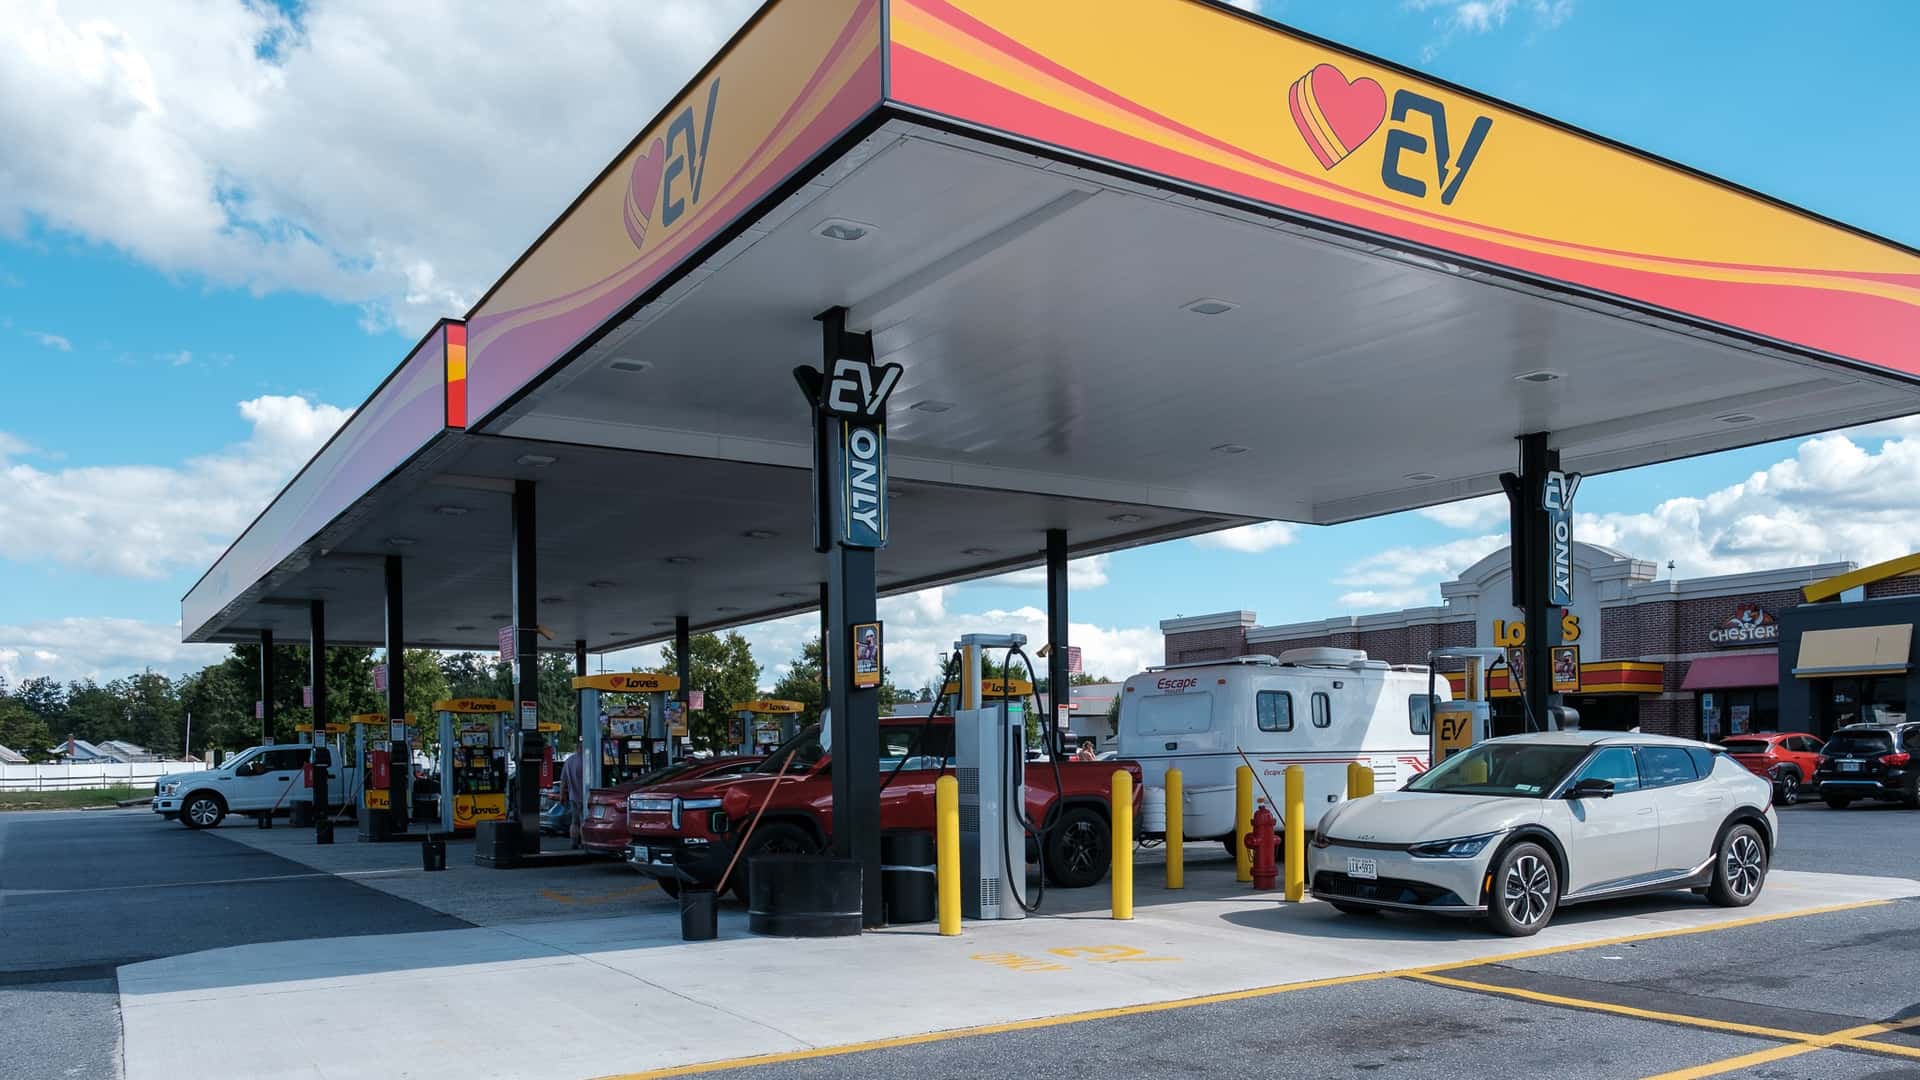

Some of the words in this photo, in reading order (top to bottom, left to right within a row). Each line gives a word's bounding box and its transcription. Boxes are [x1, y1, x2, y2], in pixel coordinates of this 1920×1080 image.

[662, 76, 720, 227] EV
[1381, 88, 1493, 206] EV
[829, 359, 901, 416] EV
[850, 428, 878, 533] ONLY
[1544, 471, 1582, 510] EV
[1554, 520, 1570, 596] ONLY
[625, 677, 658, 688] Love's
[1441, 718, 1467, 740] EV
